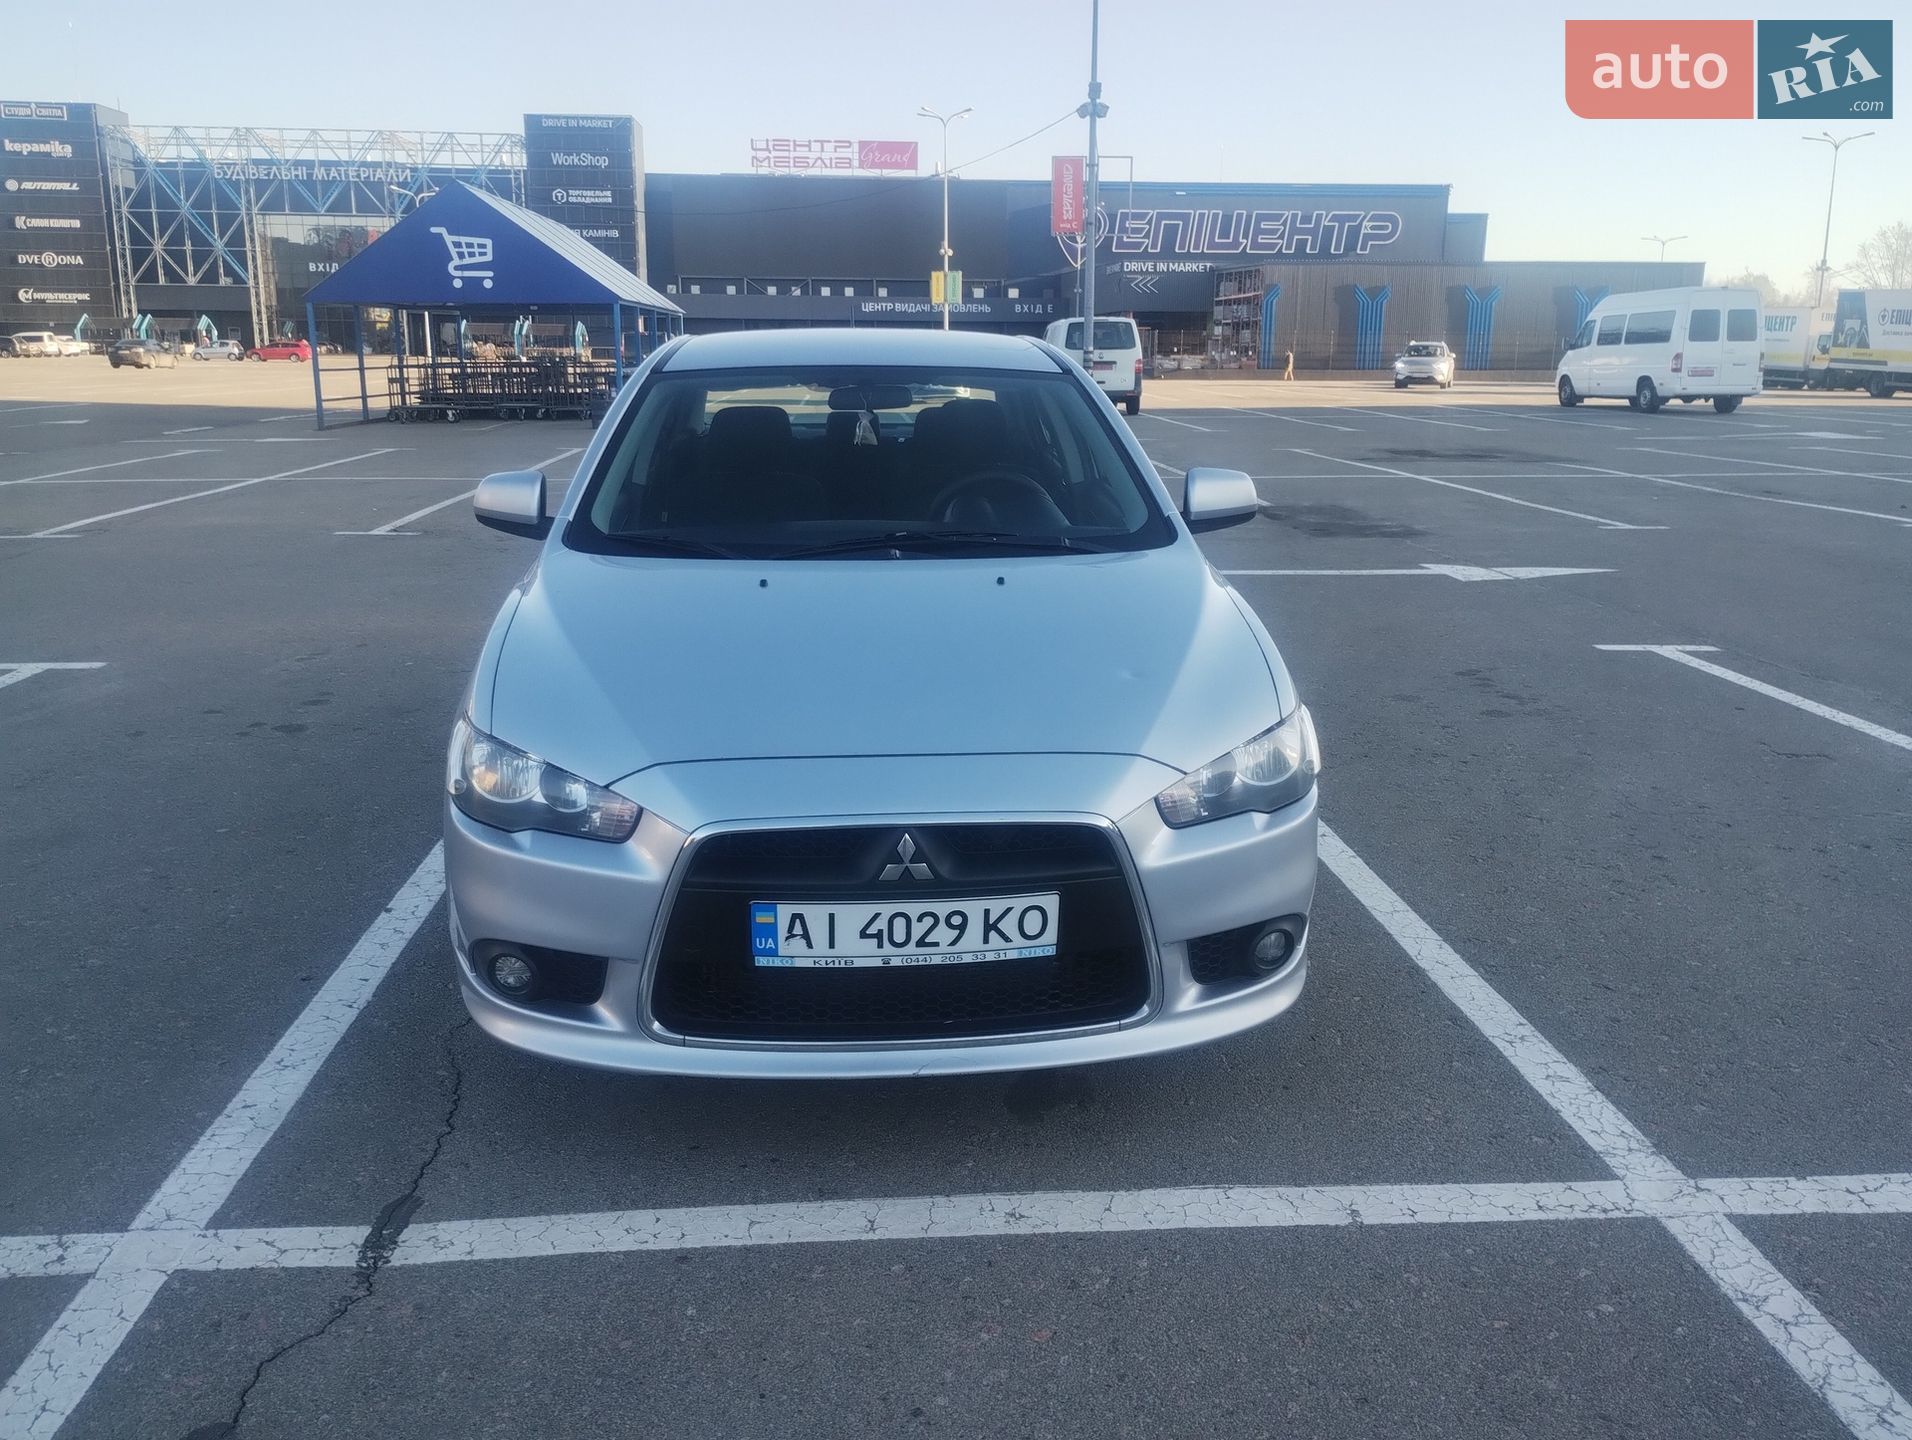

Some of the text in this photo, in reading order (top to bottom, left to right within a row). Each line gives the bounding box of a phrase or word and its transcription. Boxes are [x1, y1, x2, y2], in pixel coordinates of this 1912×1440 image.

[542, 118, 615, 129] DRIVE IN MARKET
[751, 138, 852, 154] ЦЕНТР
[551, 152, 609, 169] WorkShop
[861, 142, 916, 168] Grand
[751, 155, 852, 169] МЕБЛІВ
[214, 165, 412, 183] БУДІВЕЛЬНІ МАТЕРІАЛИ
[20, 182, 80, 191] AUTOMALL
[582, 229, 620, 238] КАМІНІВ
[1112, 208, 1402, 254] ЕПІЦЕНТР
[309, 262, 340, 274] ВХІД
[1123, 261, 1155, 272] DRIVE
[1156, 262, 1168, 272] IN
[1169, 262, 1211, 273] MARKET
[861, 302, 894, 313] ЦЕНТР
[894, 302, 931, 313] ВИДАЧІ
[1014, 303, 1043, 314] ВХІД
[784, 904, 1049, 950] AI 4029 KO
[756, 938, 775, 949] UA
[901, 951, 1008, 965] (044) 205 33 31
[1018, 947, 1054, 958] NIKO
[757, 956, 793, 966] NIKO
